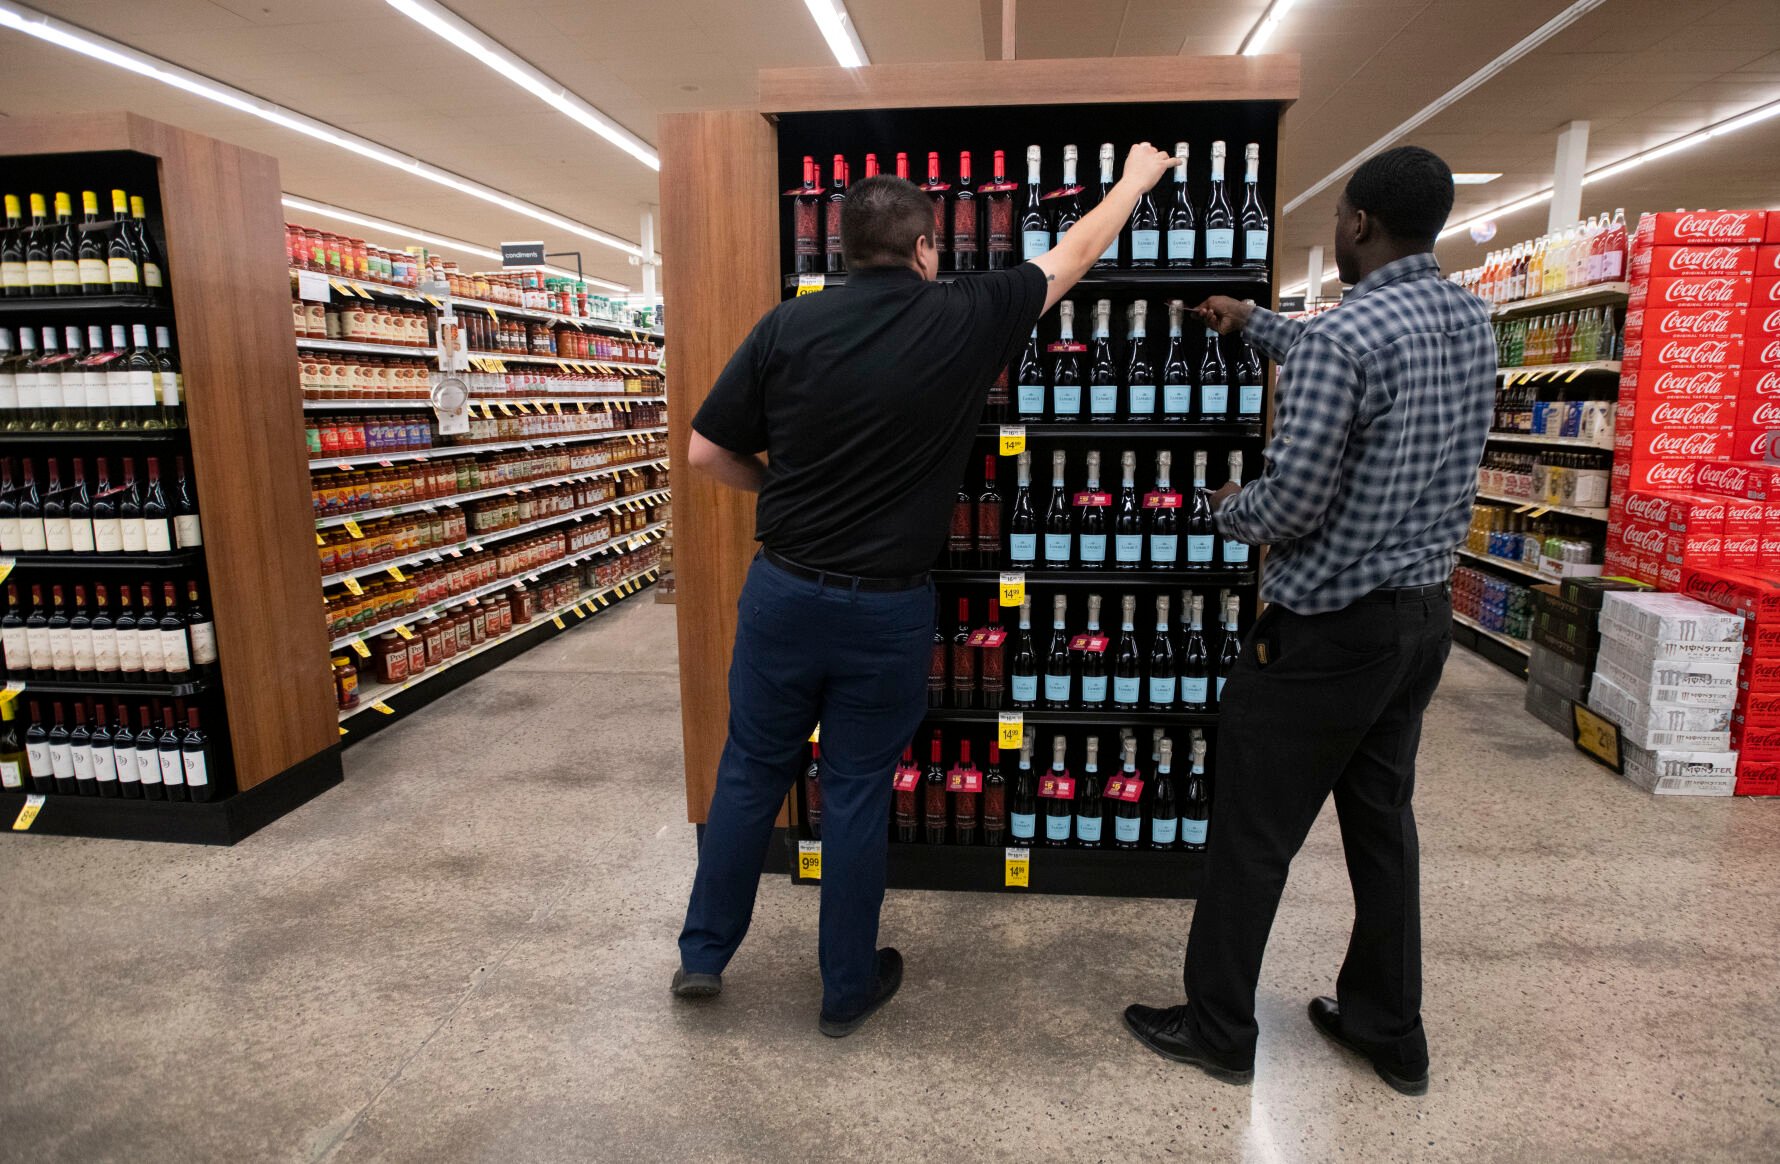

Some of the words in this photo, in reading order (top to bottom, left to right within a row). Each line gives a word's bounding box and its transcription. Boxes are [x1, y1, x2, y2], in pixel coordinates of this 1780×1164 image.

[1674, 213, 1750, 237] Coca-Cola
[1669, 246, 1744, 271] Coca-Cola
[1665, 279, 1737, 302] Coca-Cola
[1660, 310, 1733, 333] Coca-Cola
[1658, 341, 1731, 364] Coca-Cola
[1654, 372, 1727, 395] Coca-Cola
[1651, 402, 1723, 425] Coca-Cola
[1650, 432, 1721, 455] Coca-Cola
[1697, 464, 1750, 491] Coca-Cola
[1625, 494, 1672, 522] Coca-Cola
[1623, 524, 1669, 553] Coca-Cola
[1679, 644, 1732, 653] MONSTER
[801, 857, 819, 870] 999
